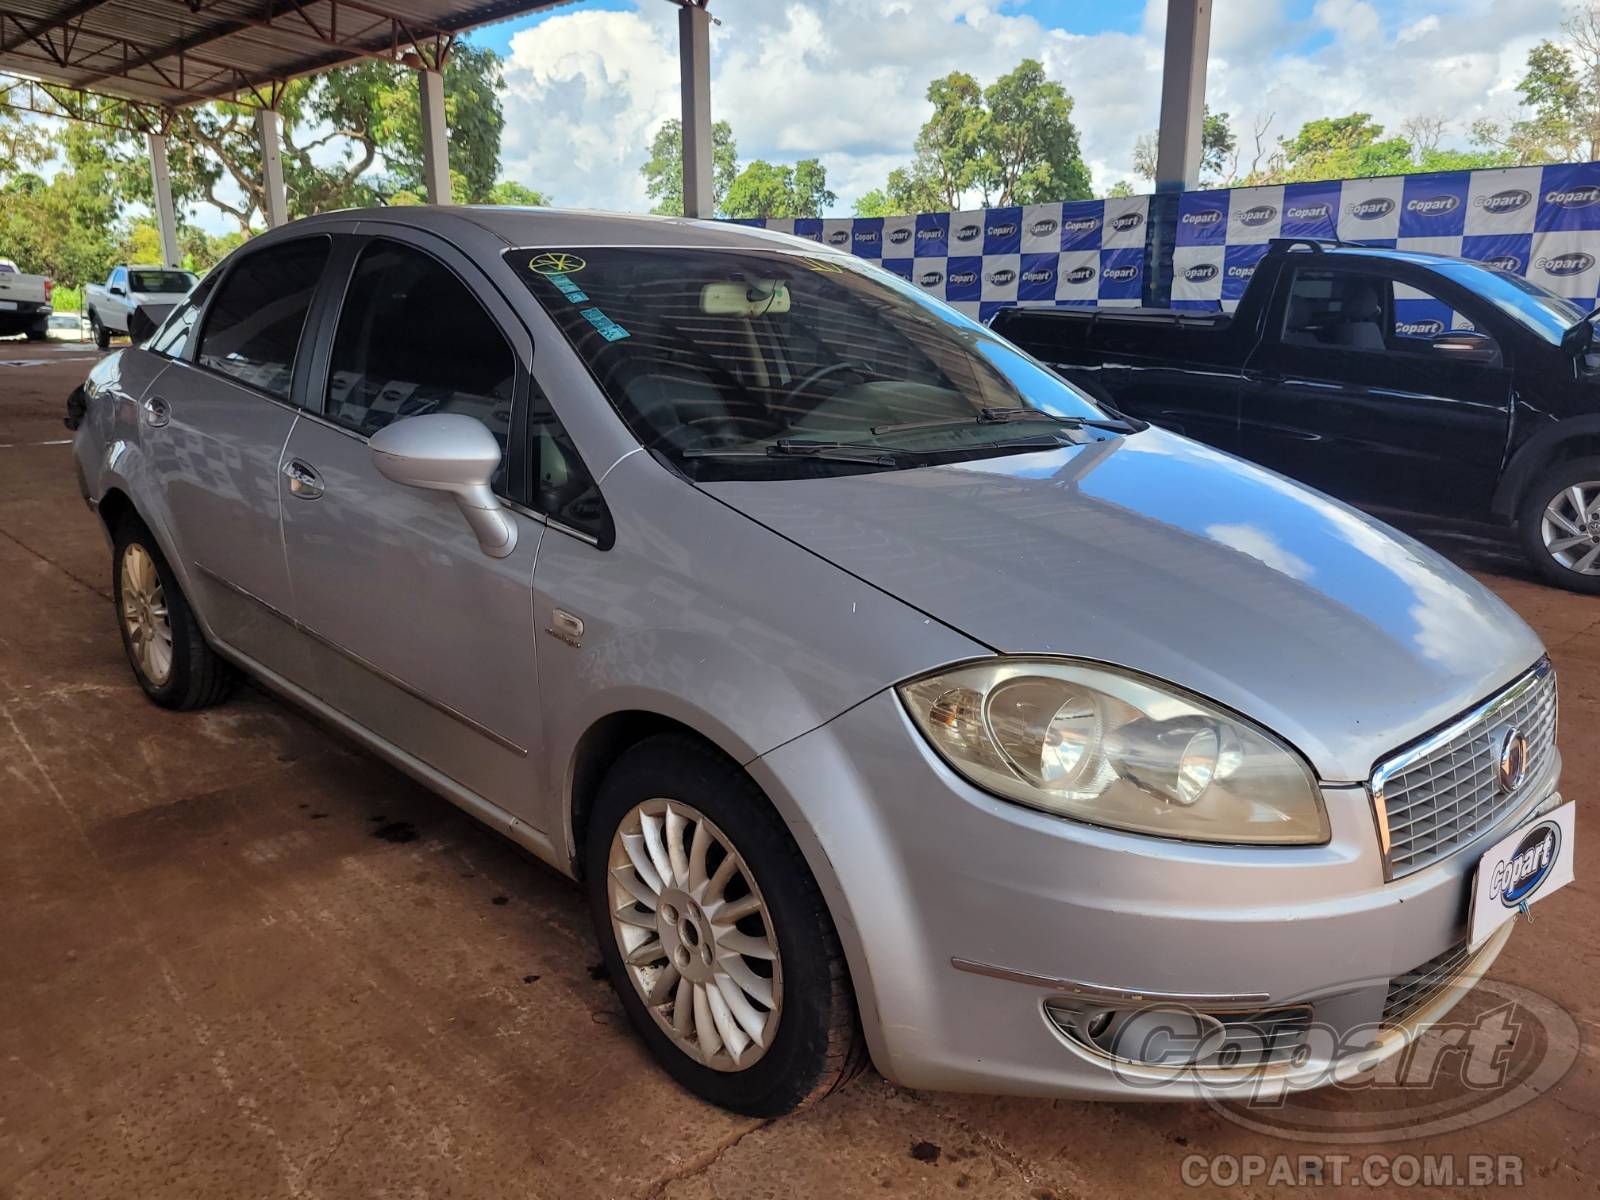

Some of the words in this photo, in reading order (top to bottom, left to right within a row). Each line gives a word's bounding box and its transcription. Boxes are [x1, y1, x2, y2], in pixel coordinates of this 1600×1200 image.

[1474, 191, 1524, 209] Copart
[1545, 189, 1598, 205] Copart
[1346, 200, 1389, 215] Copart
[1407, 196, 1453, 213] Copart
[1182, 211, 1218, 225] Copart
[1287, 205, 1329, 219] Copart
[987, 225, 1015, 238] Copart
[1064, 219, 1095, 233] Copart
[854, 232, 876, 243] Copart
[887, 230, 909, 242] opart
[917, 229, 942, 241] Copart
[1535, 256, 1587, 271] Copart
[1022, 271, 1050, 282] Copart
[1103, 268, 1135, 279] Copart
[1228, 266, 1256, 277] Copa
[949, 273, 975, 284] Copart
[1395, 321, 1438, 334] Copart
[1489, 829, 1553, 900] Copart
